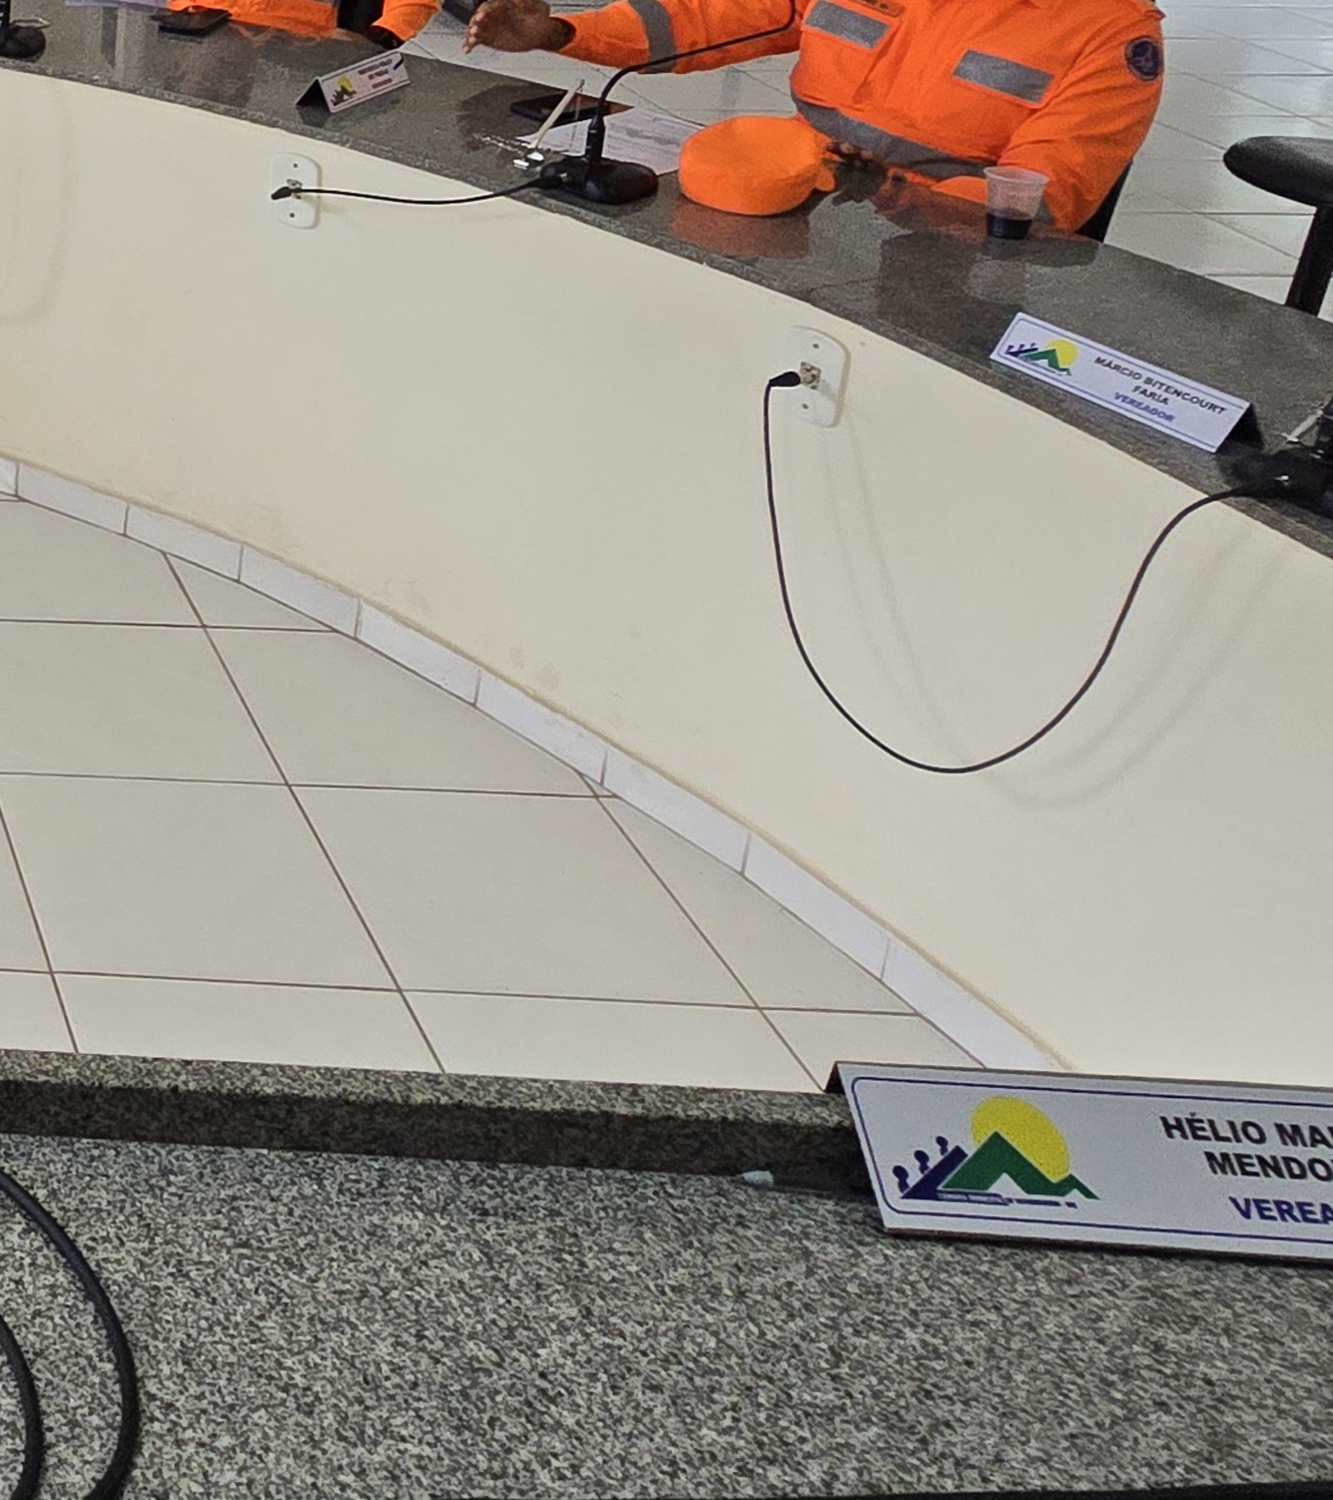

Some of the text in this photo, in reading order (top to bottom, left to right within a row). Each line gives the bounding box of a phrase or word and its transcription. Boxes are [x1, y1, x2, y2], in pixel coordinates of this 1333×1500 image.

[1114, 391, 1176, 422] VEREADOR
[1132, 385, 1170, 406] FARIA
[1143, 376, 1227, 415] BITENCOURT
[1159, 1111, 1333, 1149] HÉLIO MA
